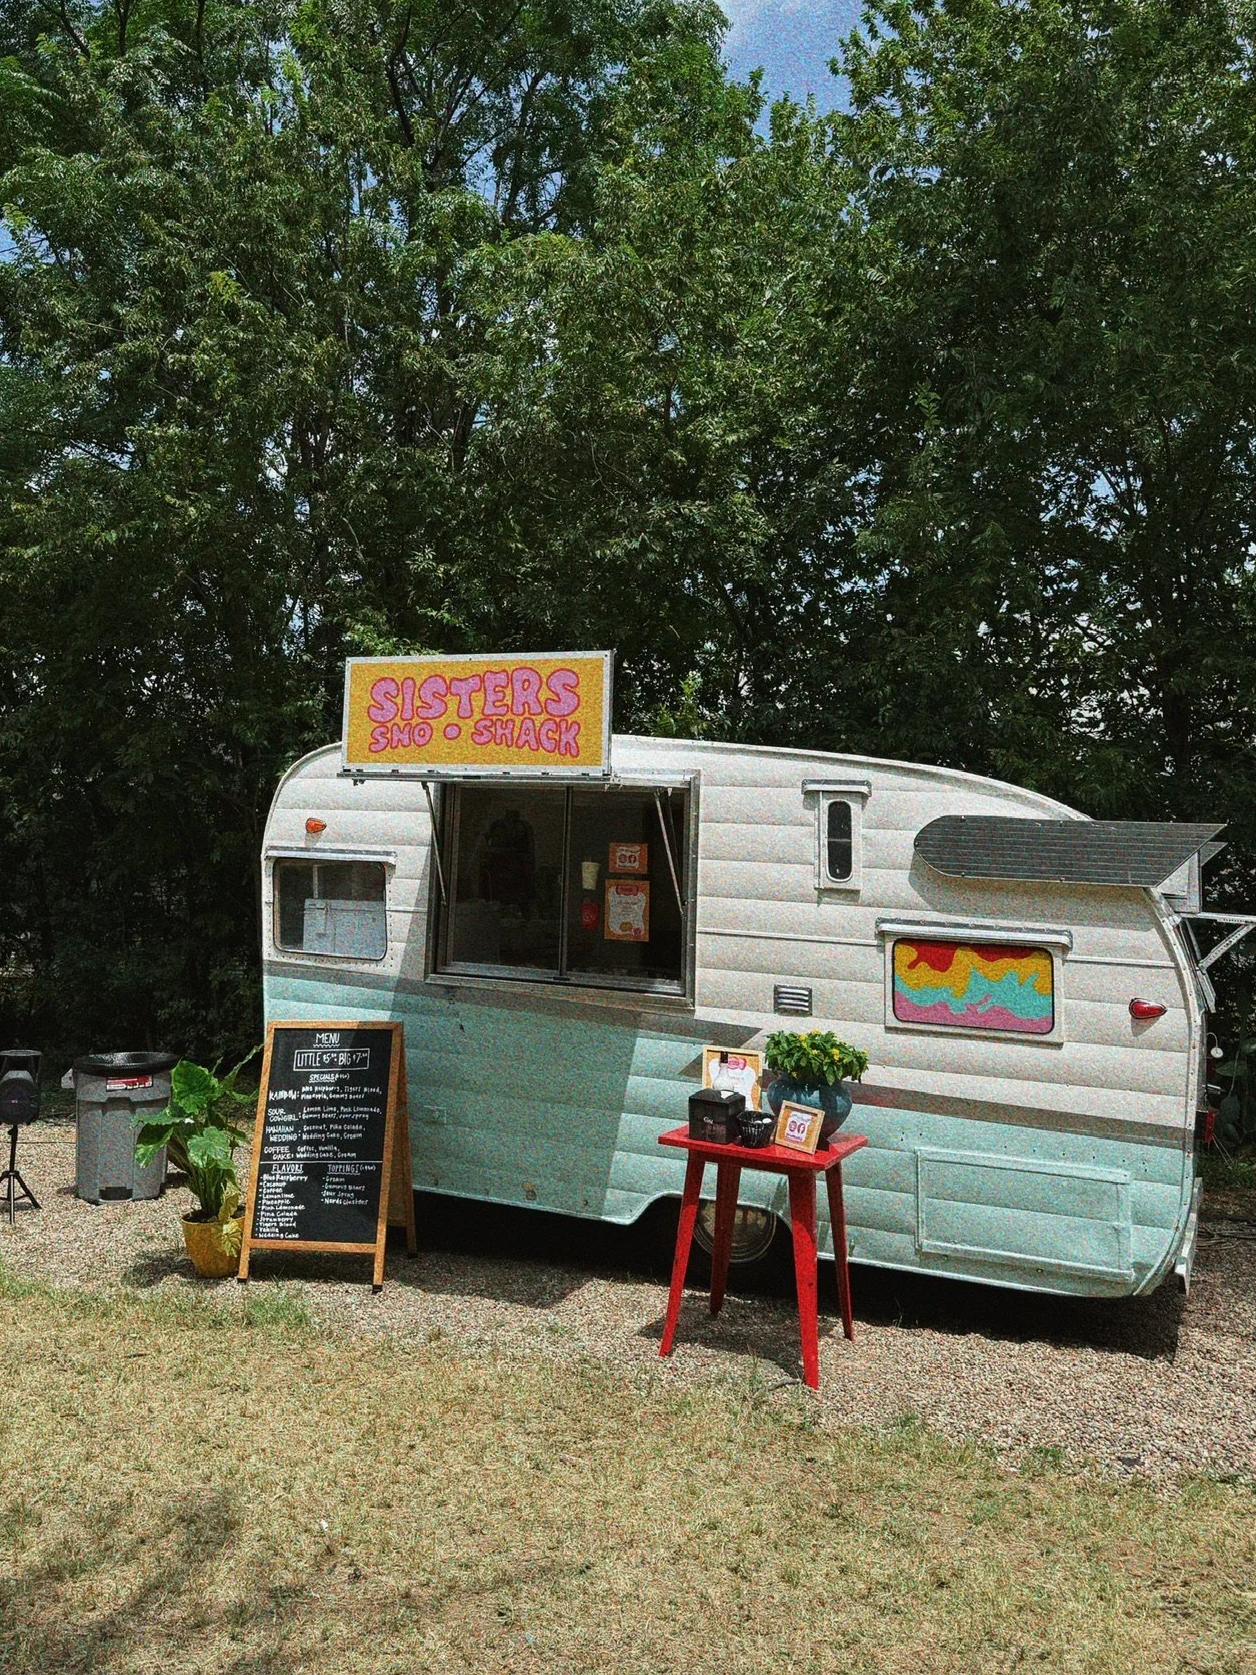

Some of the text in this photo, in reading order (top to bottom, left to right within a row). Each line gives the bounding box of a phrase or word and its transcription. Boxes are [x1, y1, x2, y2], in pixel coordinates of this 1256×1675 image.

[367, 667, 581, 723] SISTERS
[369, 717, 581, 758] SNO SHACK
[315, 1033, 340, 1044] MENU
[297, 1052, 322, 1067] LITTLE
[338, 1053, 351, 1066] BIG
[309, 1073, 335, 1081] SPECIALS
[267, 1108, 286, 1116] SOUR
[265, 1125, 294, 1134] HAWAIIAN
[264, 1146, 290, 1154] COFFEE
[272, 1164, 304, 1172] FLAVORS
[327, 1164, 360, 1173] TOPPINGS
